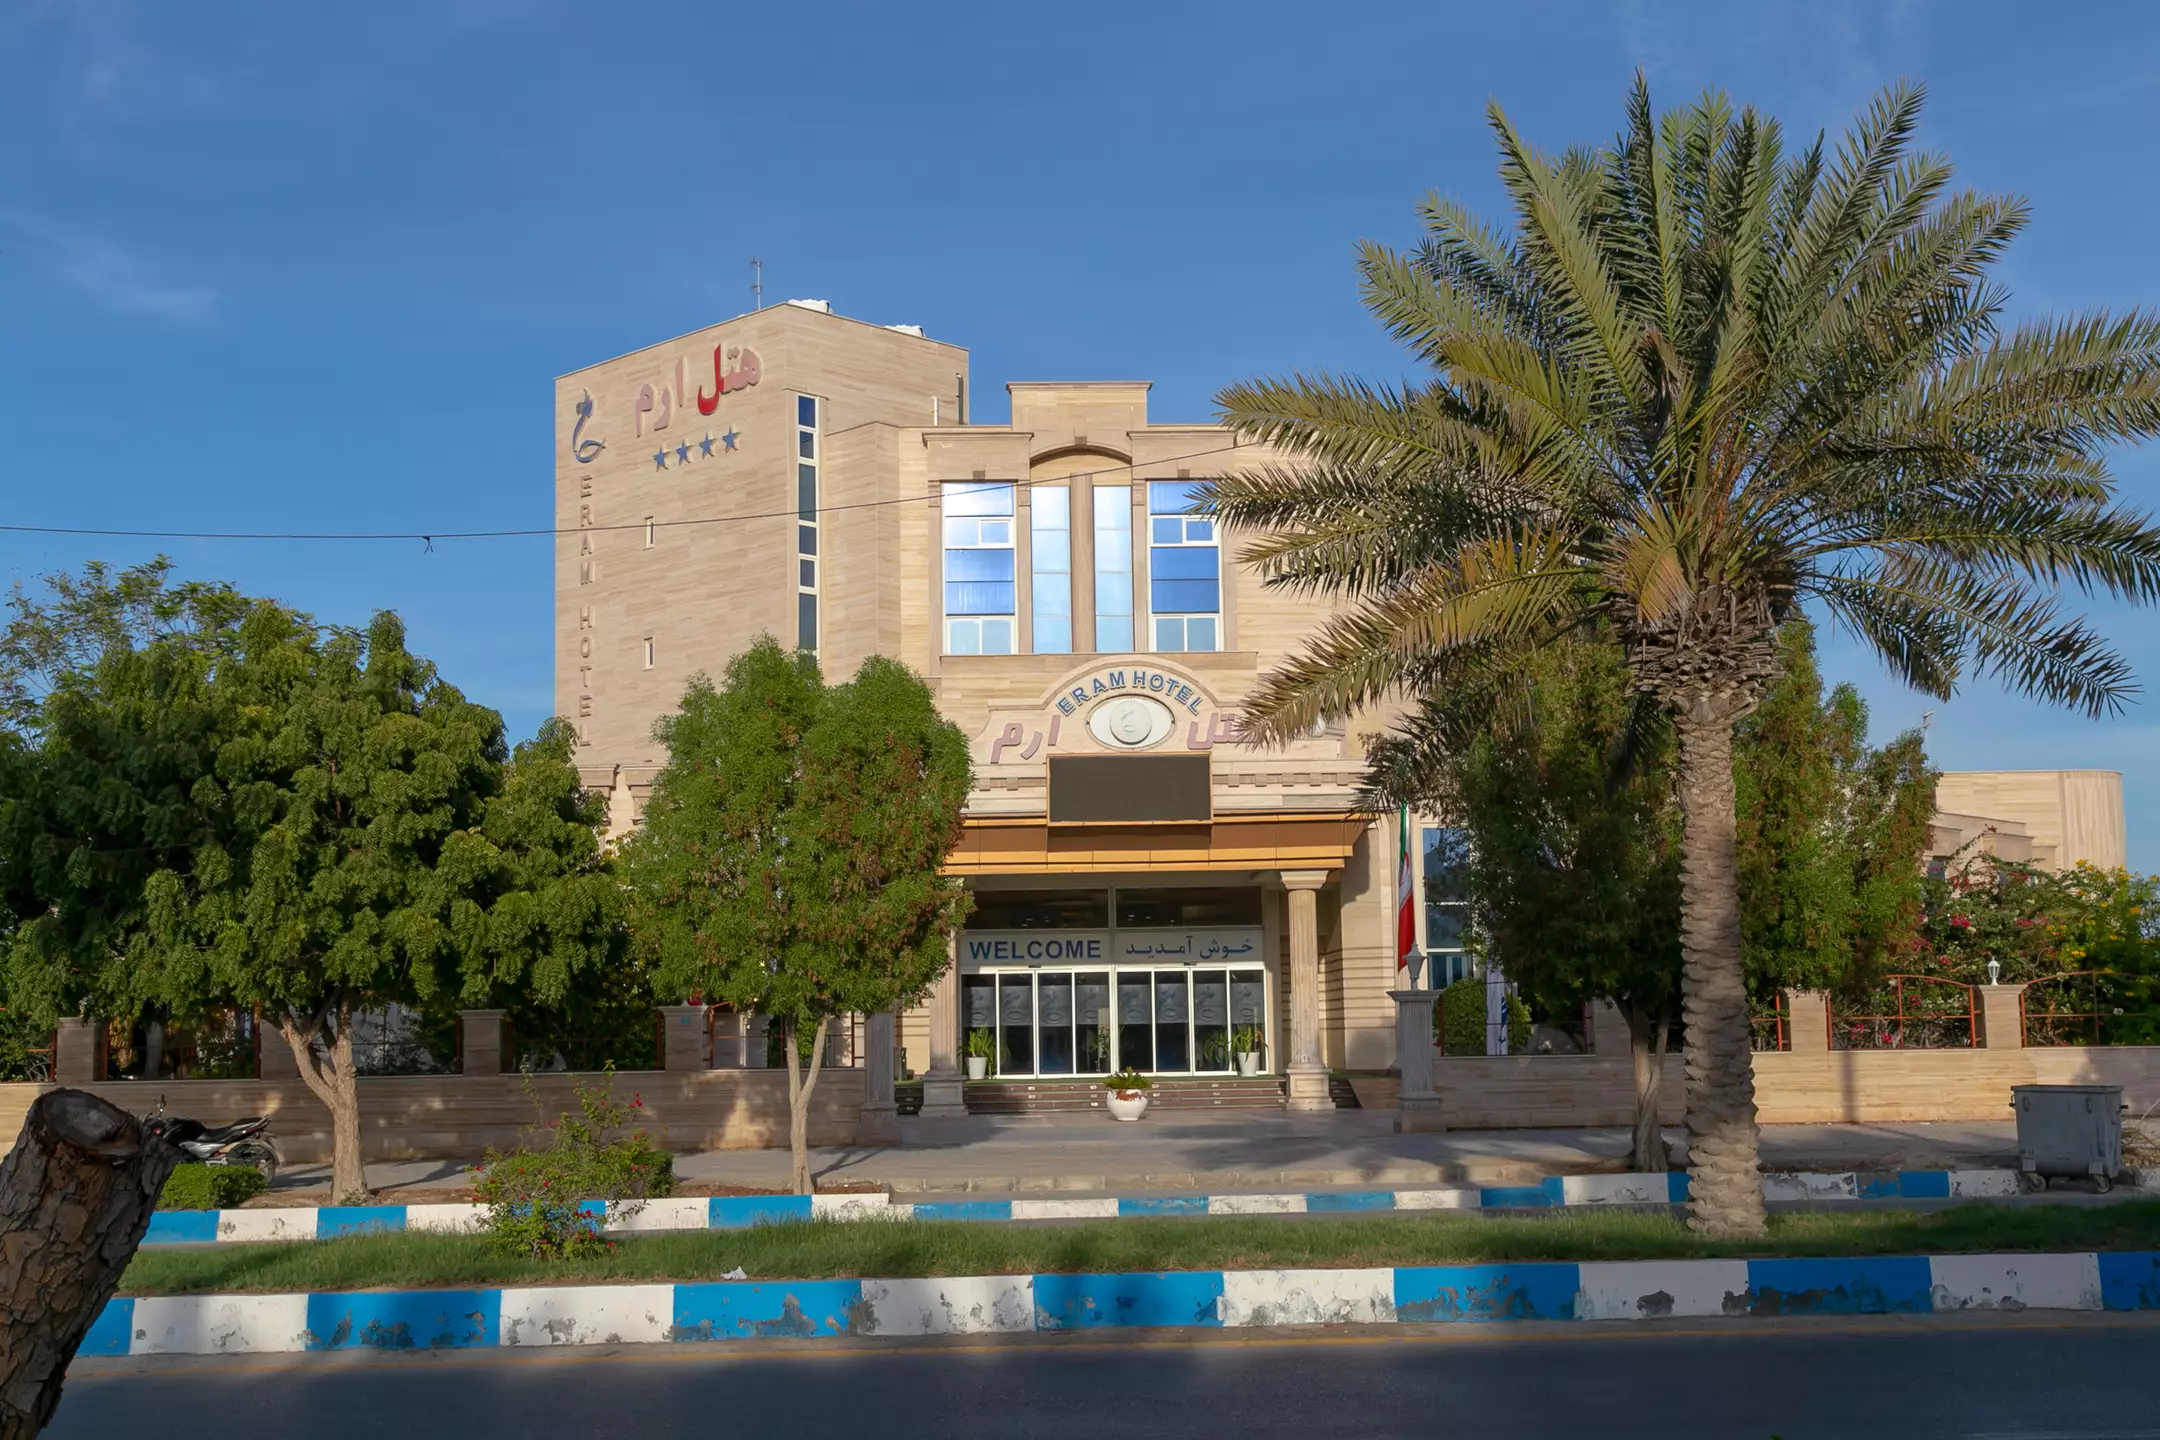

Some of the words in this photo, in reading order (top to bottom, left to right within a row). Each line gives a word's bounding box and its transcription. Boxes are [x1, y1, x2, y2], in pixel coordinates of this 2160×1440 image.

[634, 357, 684, 438] ارم
[697, 343, 761, 416] هتل
[580, 474, 594, 586] ERAM
[579, 606, 593, 747] HOTEL
[1056, 671, 1126, 717] ERAM
[1132, 671, 1204, 717] HOTEL
[990, 714, 1061, 764] ارم
[968, 939, 1102, 960] WELCOME
[1125, 935, 1194, 959] آمدید
[1199, 938, 1254, 960] خوش
